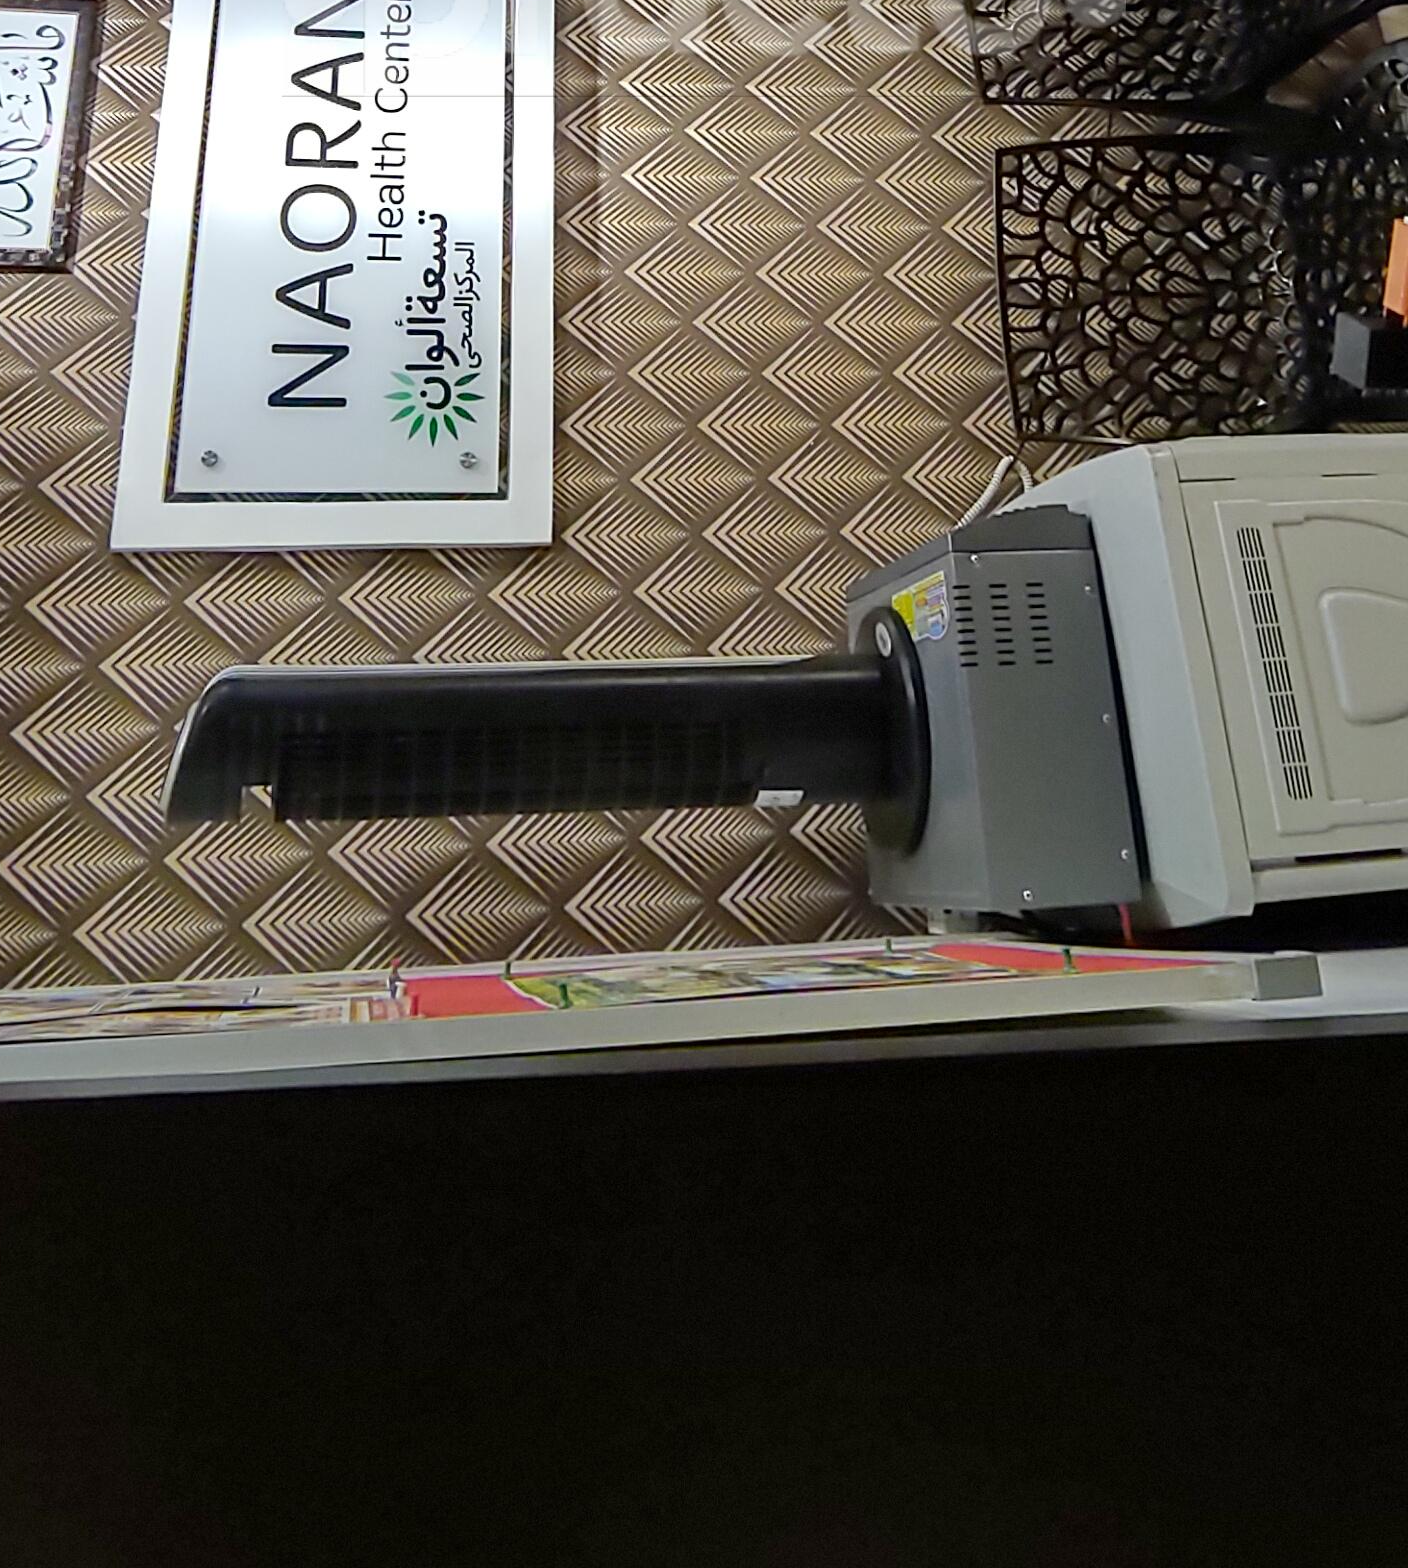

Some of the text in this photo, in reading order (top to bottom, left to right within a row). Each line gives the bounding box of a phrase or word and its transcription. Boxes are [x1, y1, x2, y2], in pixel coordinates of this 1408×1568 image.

[366, 131, 407, 262] Health
[393, 209, 461, 411] تسعة ألوان
